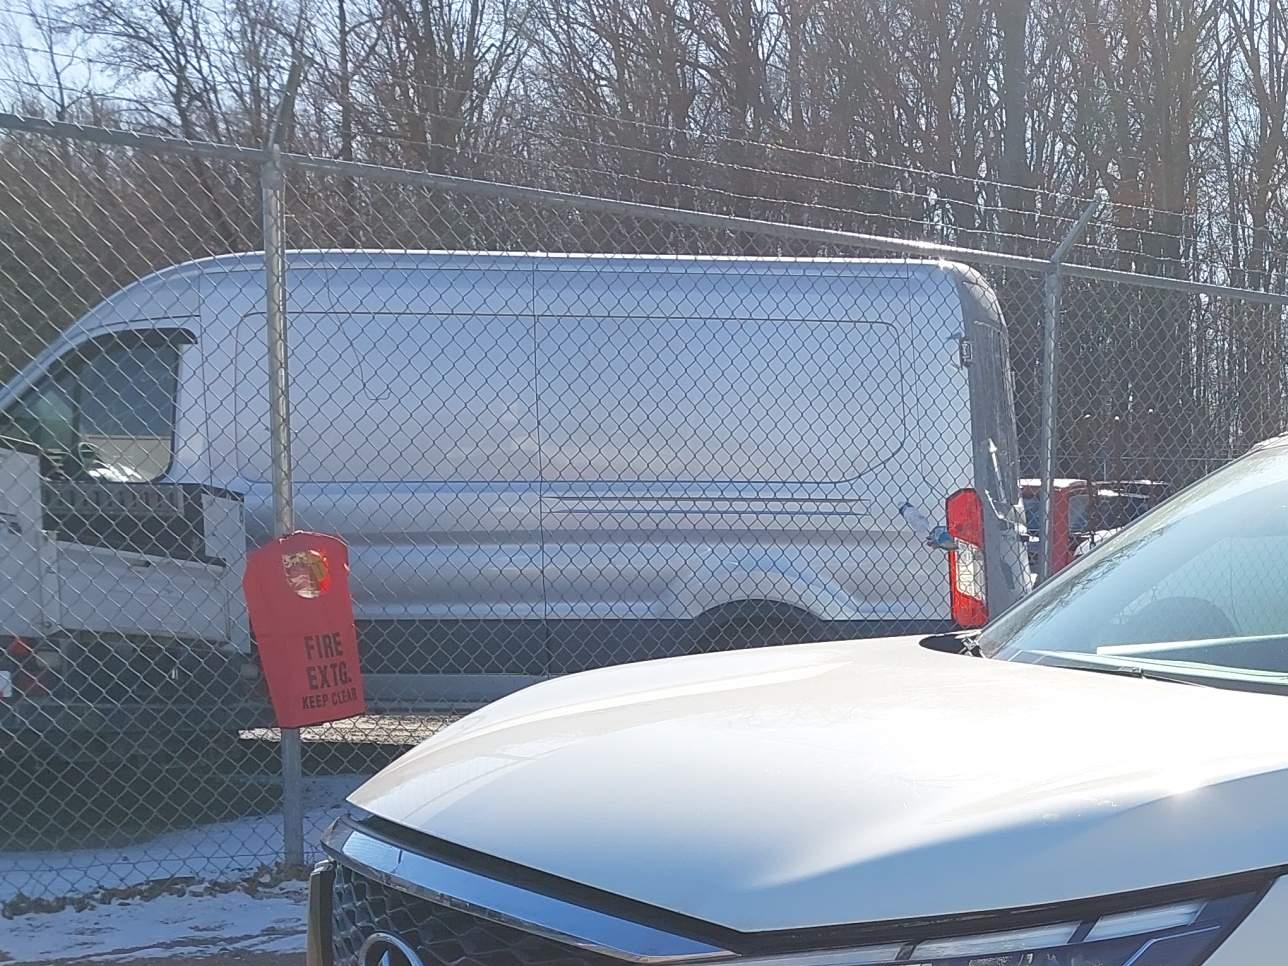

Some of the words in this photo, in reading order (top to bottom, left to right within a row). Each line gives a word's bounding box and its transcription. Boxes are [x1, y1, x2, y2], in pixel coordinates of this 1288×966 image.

[303, 632, 343, 660] FIRE
[302, 694, 329, 710] KEEP
[331, 687, 358, 706] CLEAR
